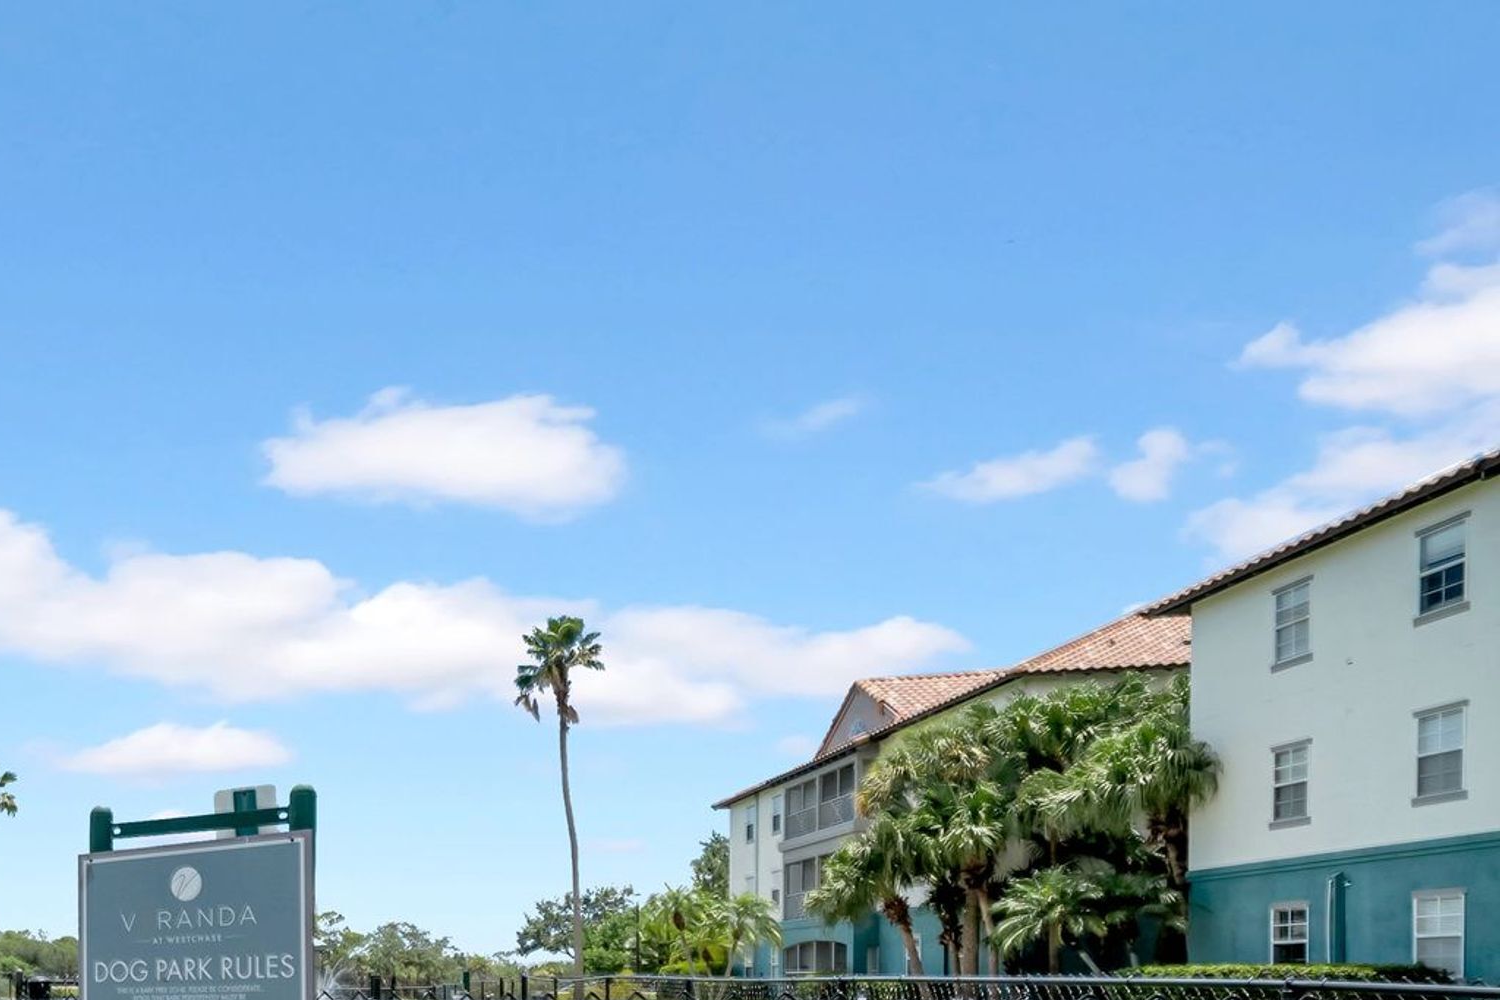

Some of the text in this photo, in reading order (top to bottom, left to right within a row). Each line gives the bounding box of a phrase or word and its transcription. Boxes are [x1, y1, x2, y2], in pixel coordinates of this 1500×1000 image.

[120, 905, 258, 933] VRANDA
[153, 934, 223, 945] AT WESTCHASE
[95, 954, 296, 983] DOG PARK RULES
